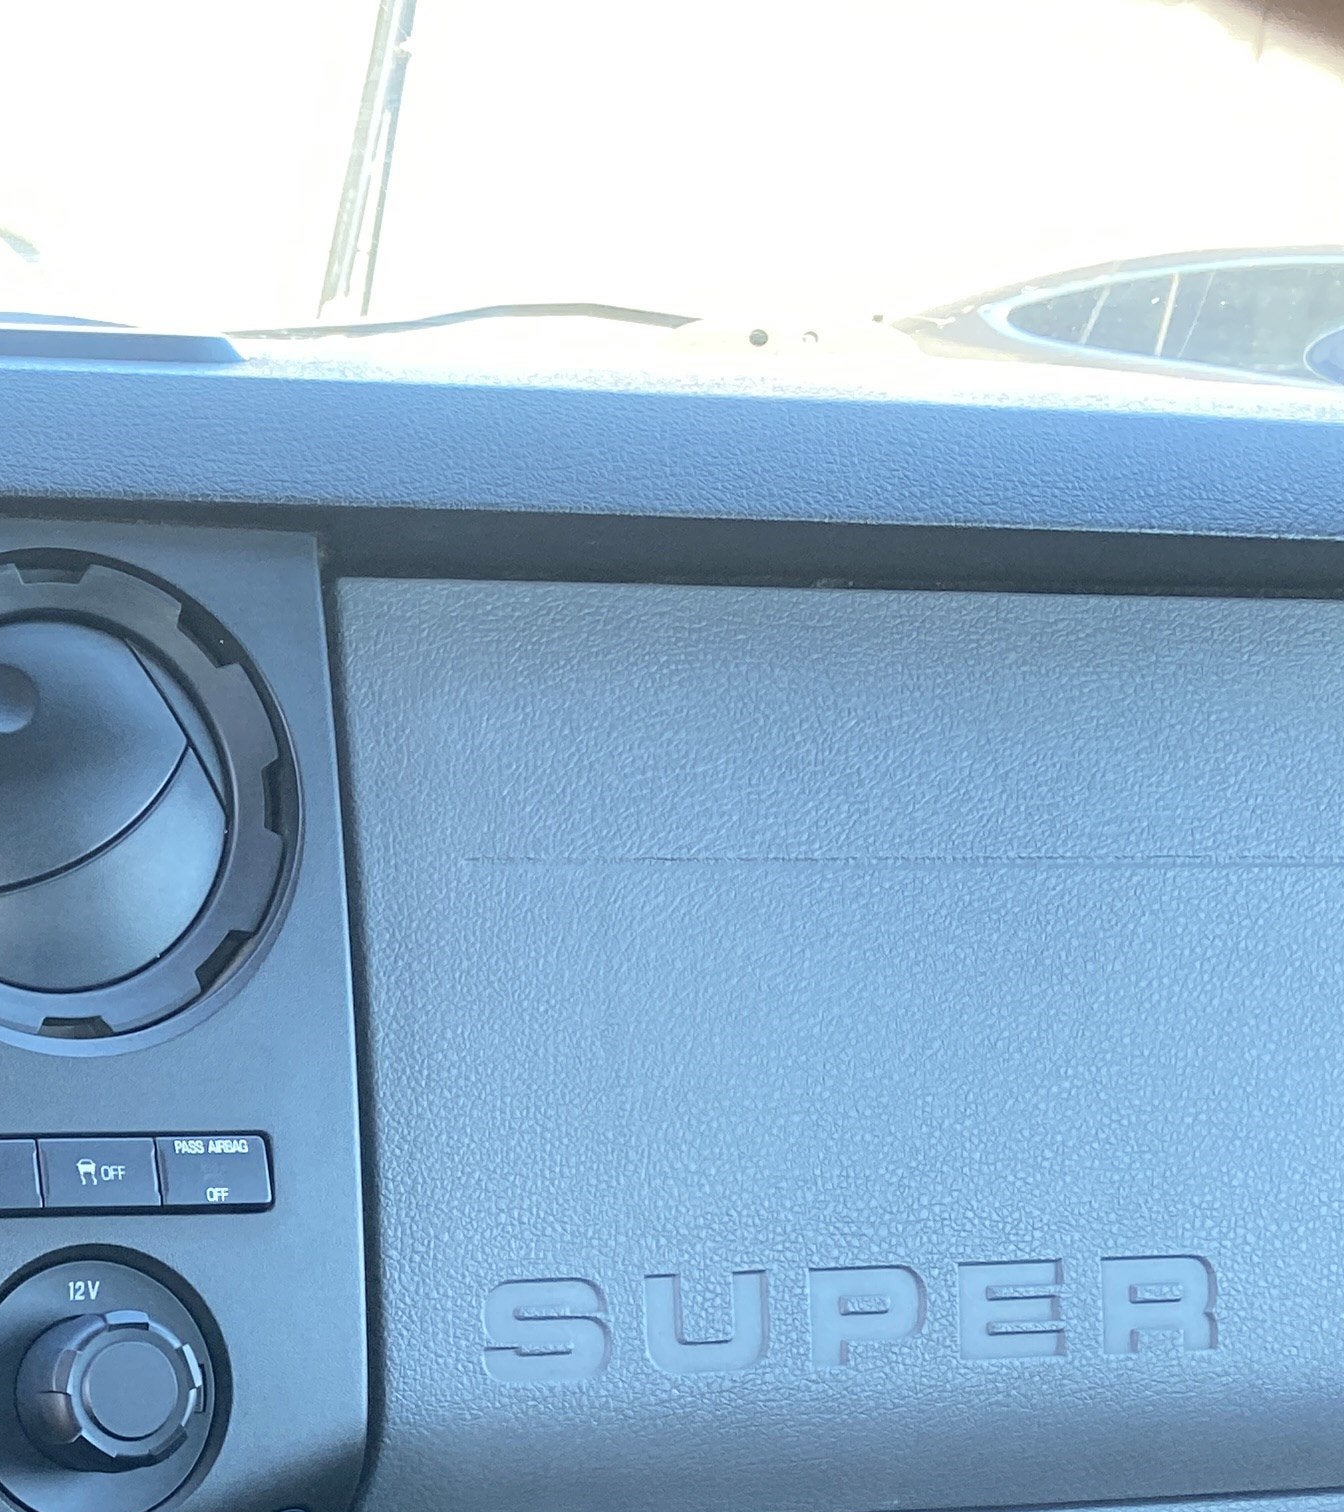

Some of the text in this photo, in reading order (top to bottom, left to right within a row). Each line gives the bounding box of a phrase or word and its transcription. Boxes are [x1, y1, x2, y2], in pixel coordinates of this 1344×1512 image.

[174, 1139, 249, 1154] PASS AIRBAG
[100, 1165, 126, 1181] OFF
[206, 1187, 229, 1202] OFF
[480, 1254, 1219, 1384] SUPER
